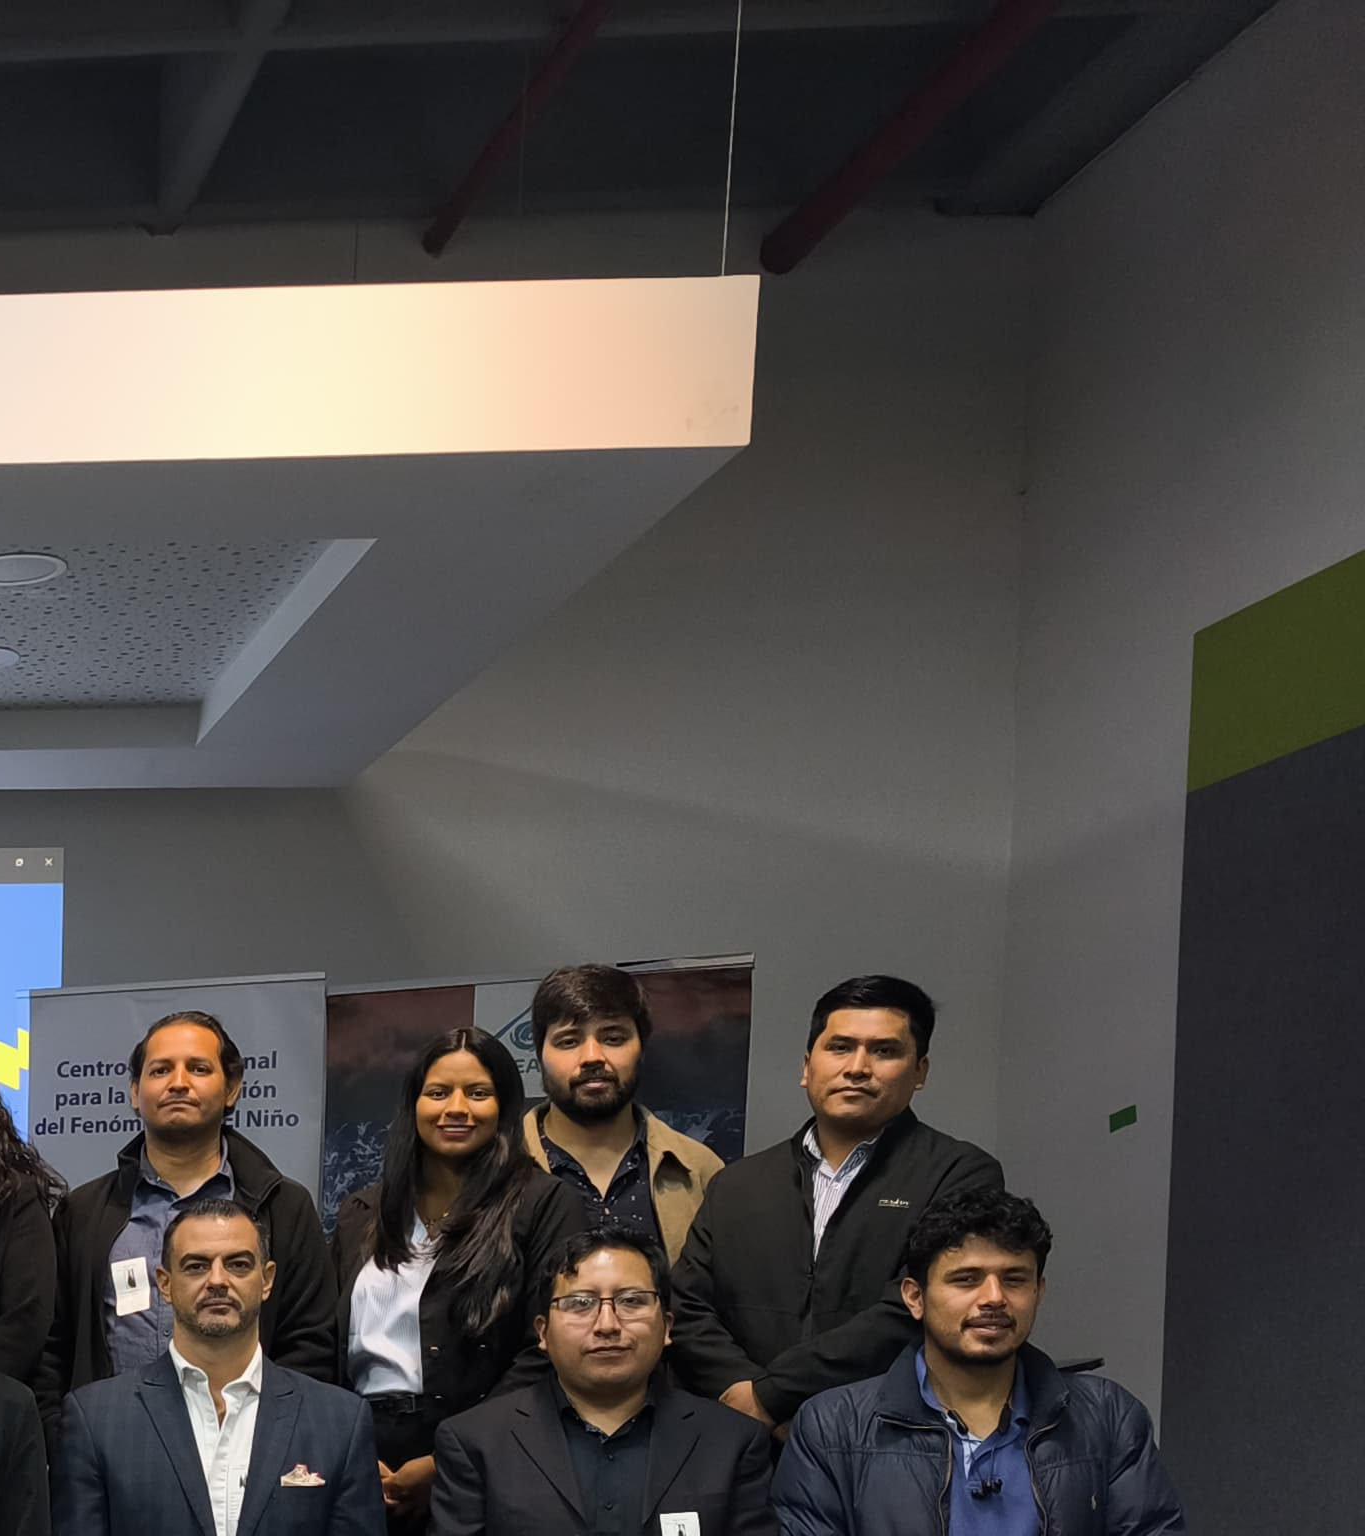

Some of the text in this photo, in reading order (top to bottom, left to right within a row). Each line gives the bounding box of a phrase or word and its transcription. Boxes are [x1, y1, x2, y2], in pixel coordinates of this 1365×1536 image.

[57, 1060, 127, 1078] Centro
[55, 1087, 125, 1111] para la
[34, 1116, 65, 1136] del
[70, 1114, 142, 1134] Fenóm
[246, 1109, 300, 1129] Niño
